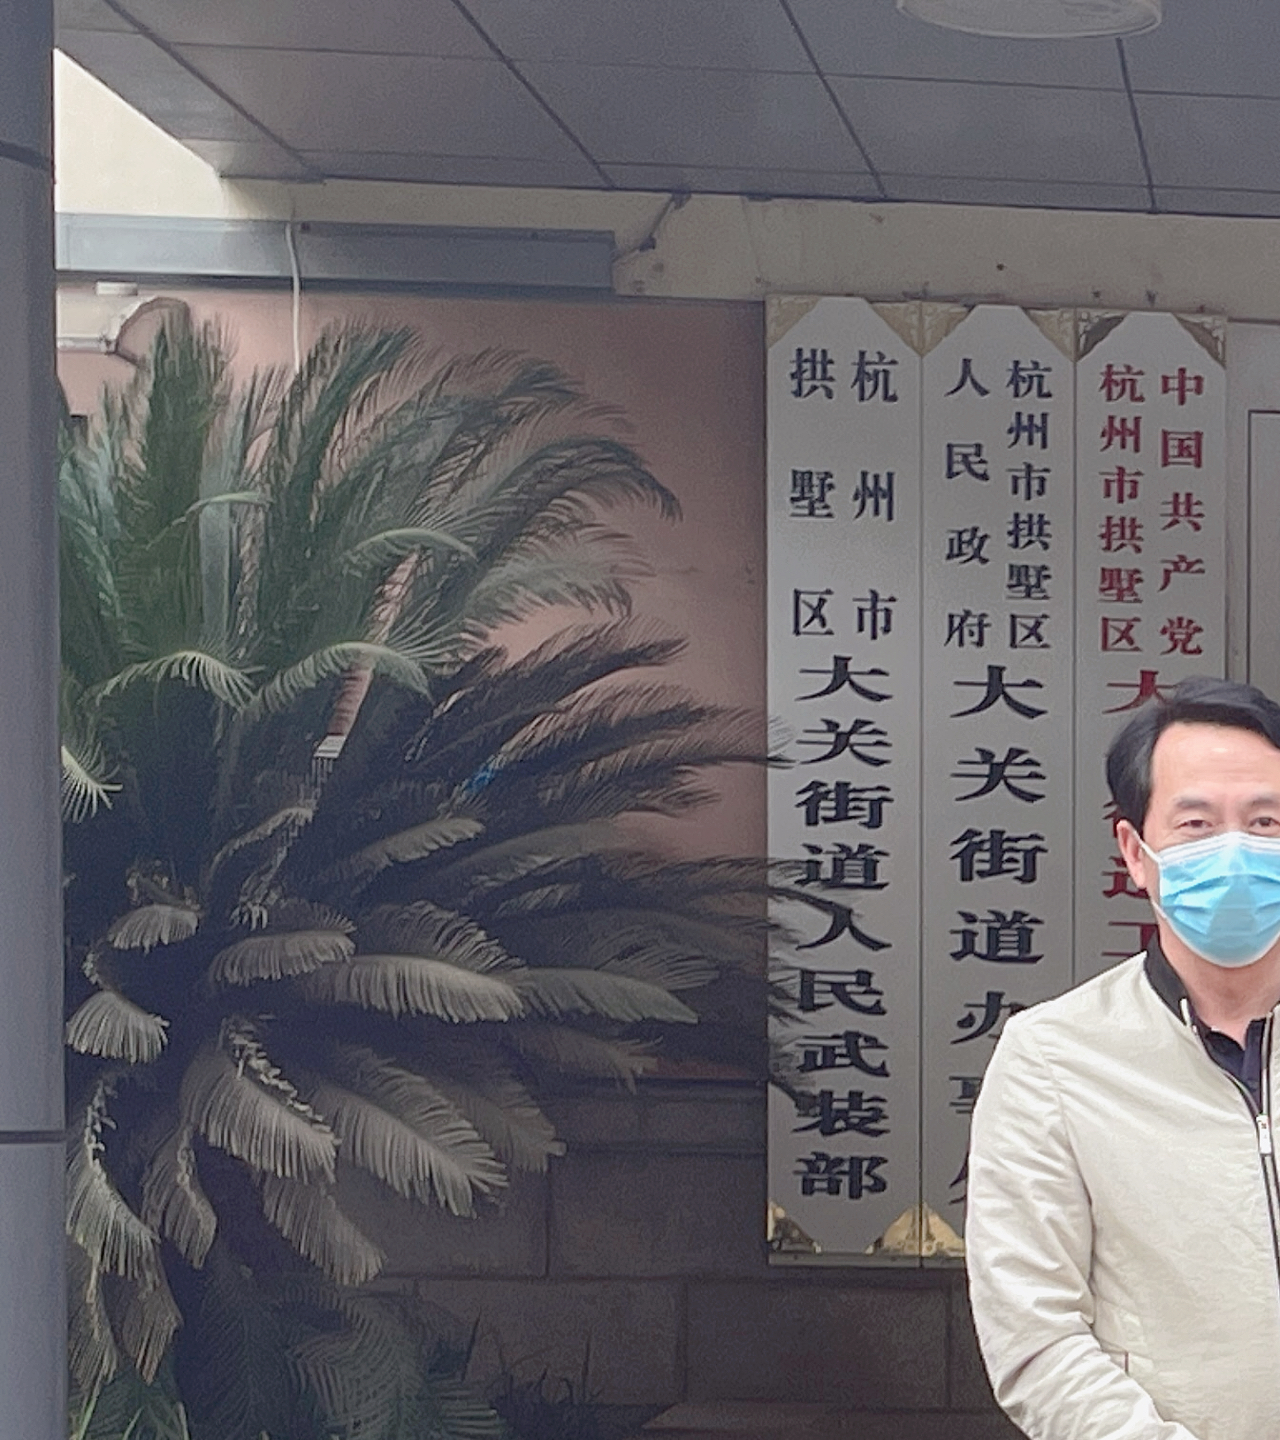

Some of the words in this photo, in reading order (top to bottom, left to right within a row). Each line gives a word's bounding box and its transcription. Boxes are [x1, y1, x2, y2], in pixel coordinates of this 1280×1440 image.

[789, 347, 835, 636] 拱墅区
[852, 350, 898, 640] 杭州市
[944, 358, 990, 647] 人民政府
[1006, 360, 1052, 649] 杭州市拱墅区
[1100, 363, 1145, 652] 杭州市拱墅区
[1159, 367, 1205, 655] 中国共产党
[792, 655, 893, 1199] 大关街道人民武装部
